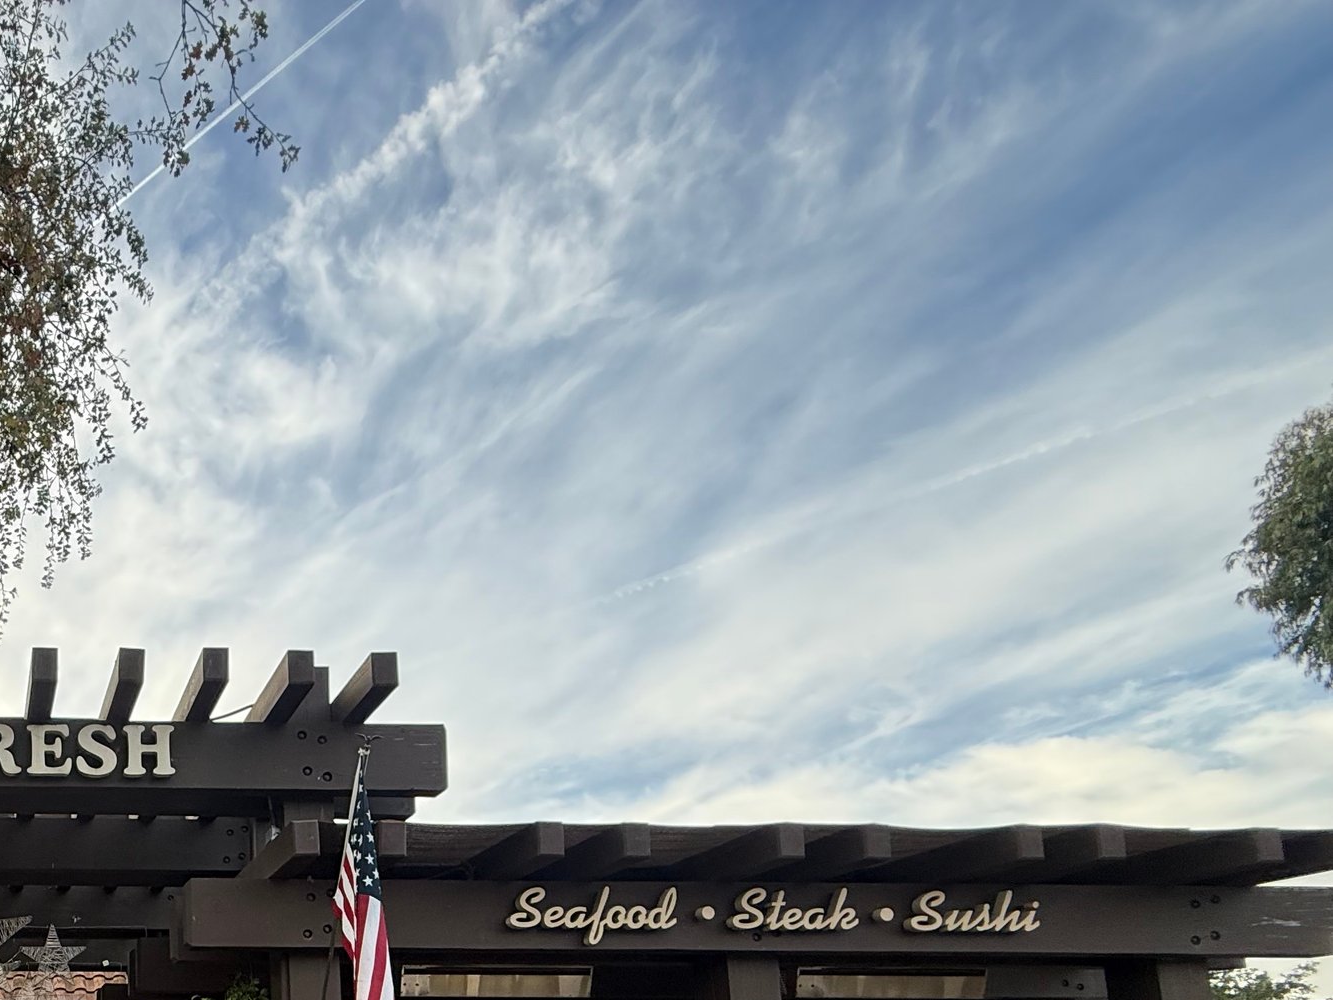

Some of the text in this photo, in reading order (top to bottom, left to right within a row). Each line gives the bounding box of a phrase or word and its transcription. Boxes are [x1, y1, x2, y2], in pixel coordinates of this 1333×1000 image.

[506, 886, 1041, 945] Seafood Steak Sushi
